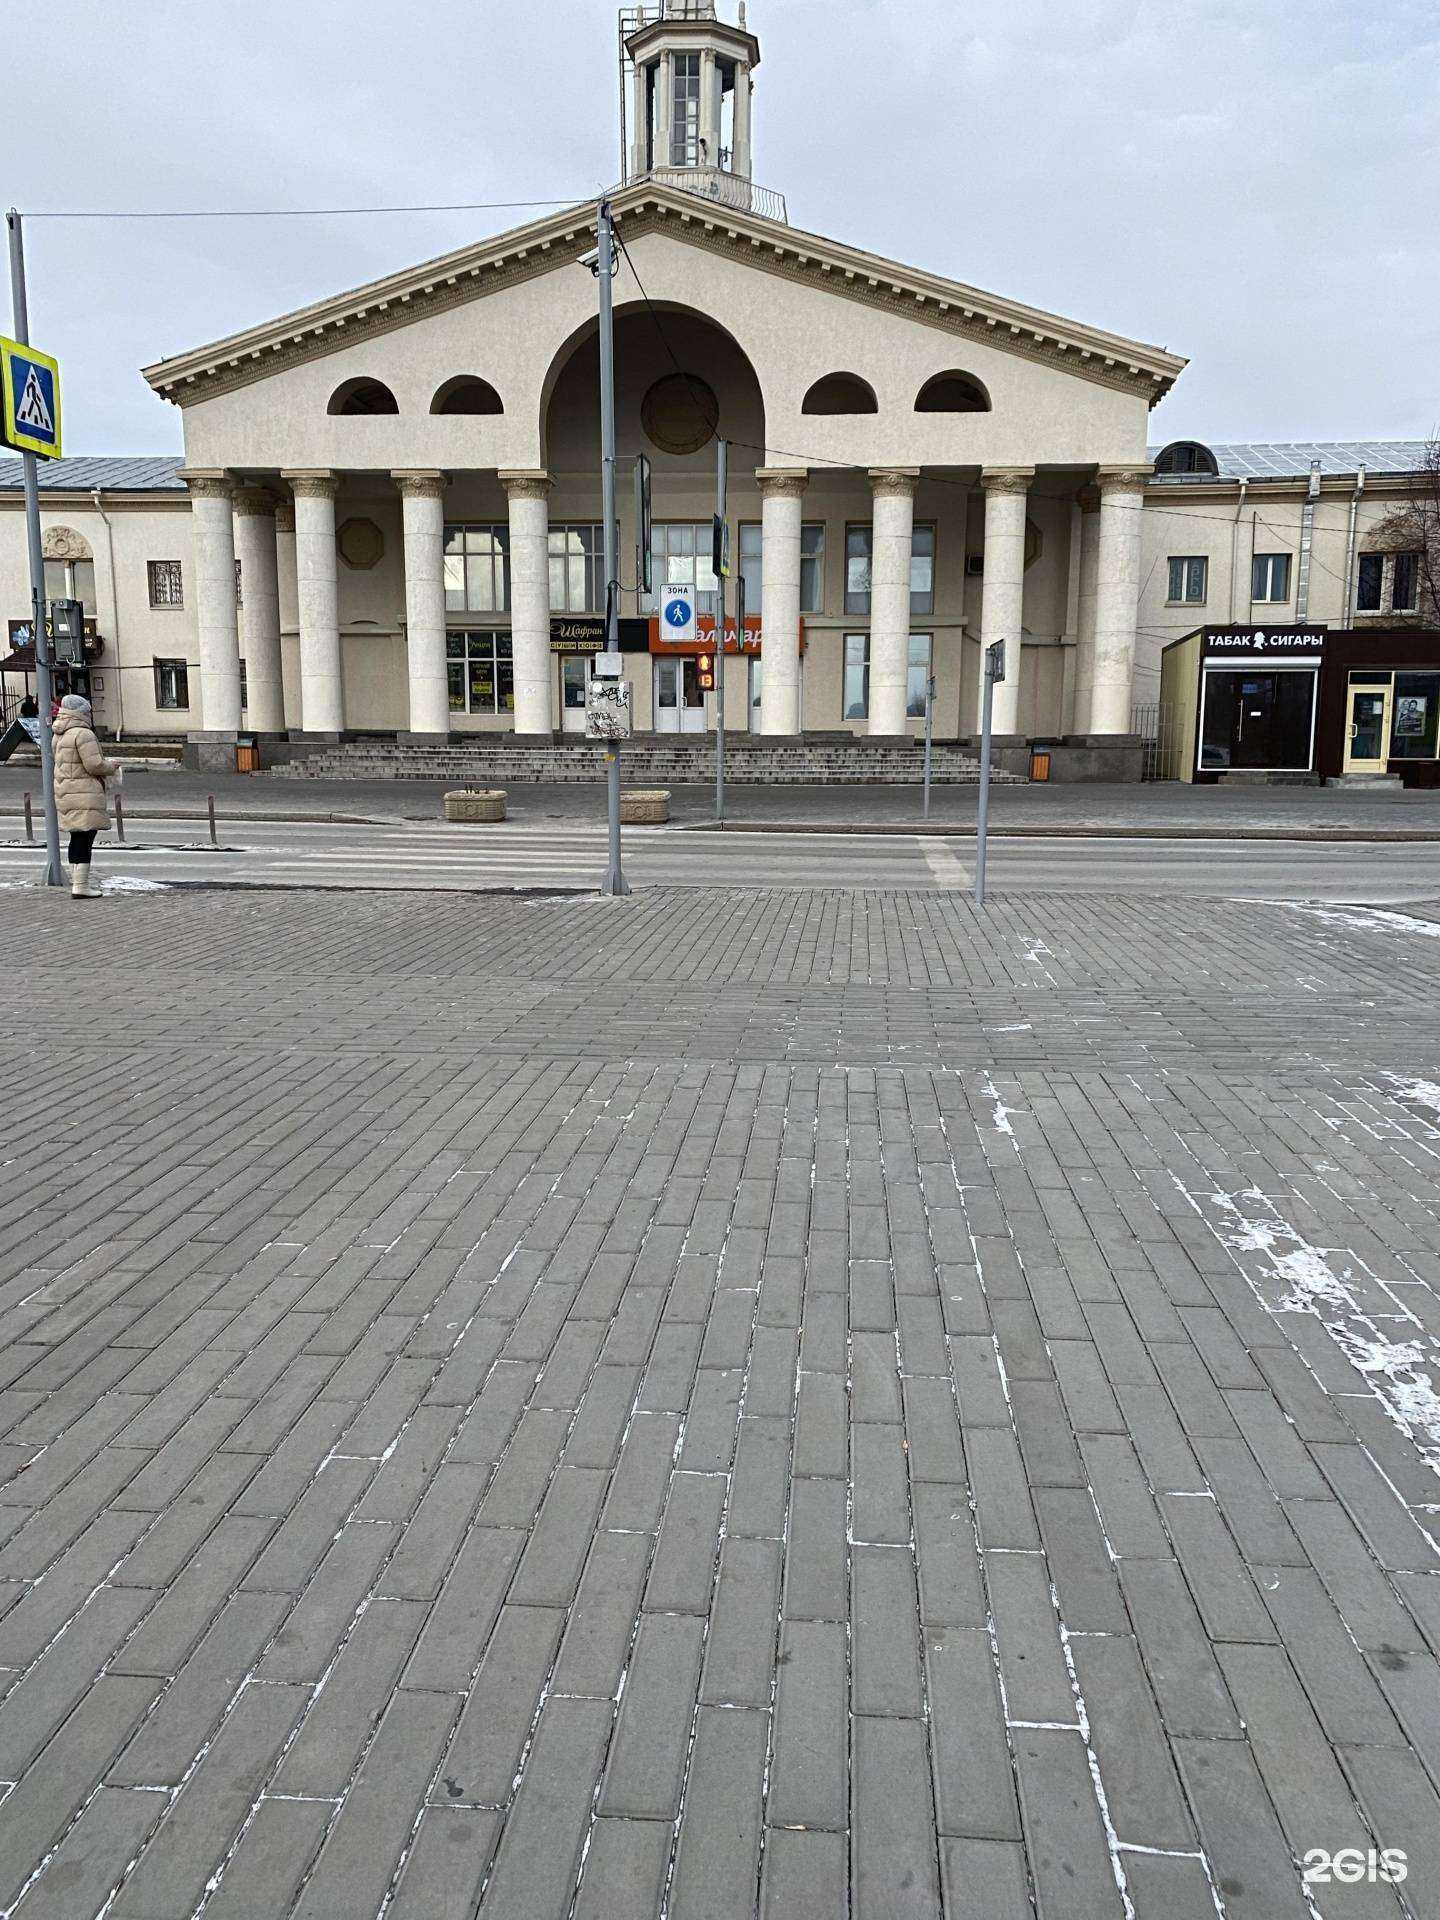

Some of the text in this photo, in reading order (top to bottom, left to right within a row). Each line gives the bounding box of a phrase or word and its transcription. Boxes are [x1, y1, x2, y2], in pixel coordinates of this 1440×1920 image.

[667, 586, 689, 595] ЗОНА
[552, 623, 603, 638] Шафран
[550, 642, 603, 650] СУШИ КОФЕ
[1208, 635, 1323, 646] ТАБАК СИГАРЫ
[701, 674, 713, 687] 13
